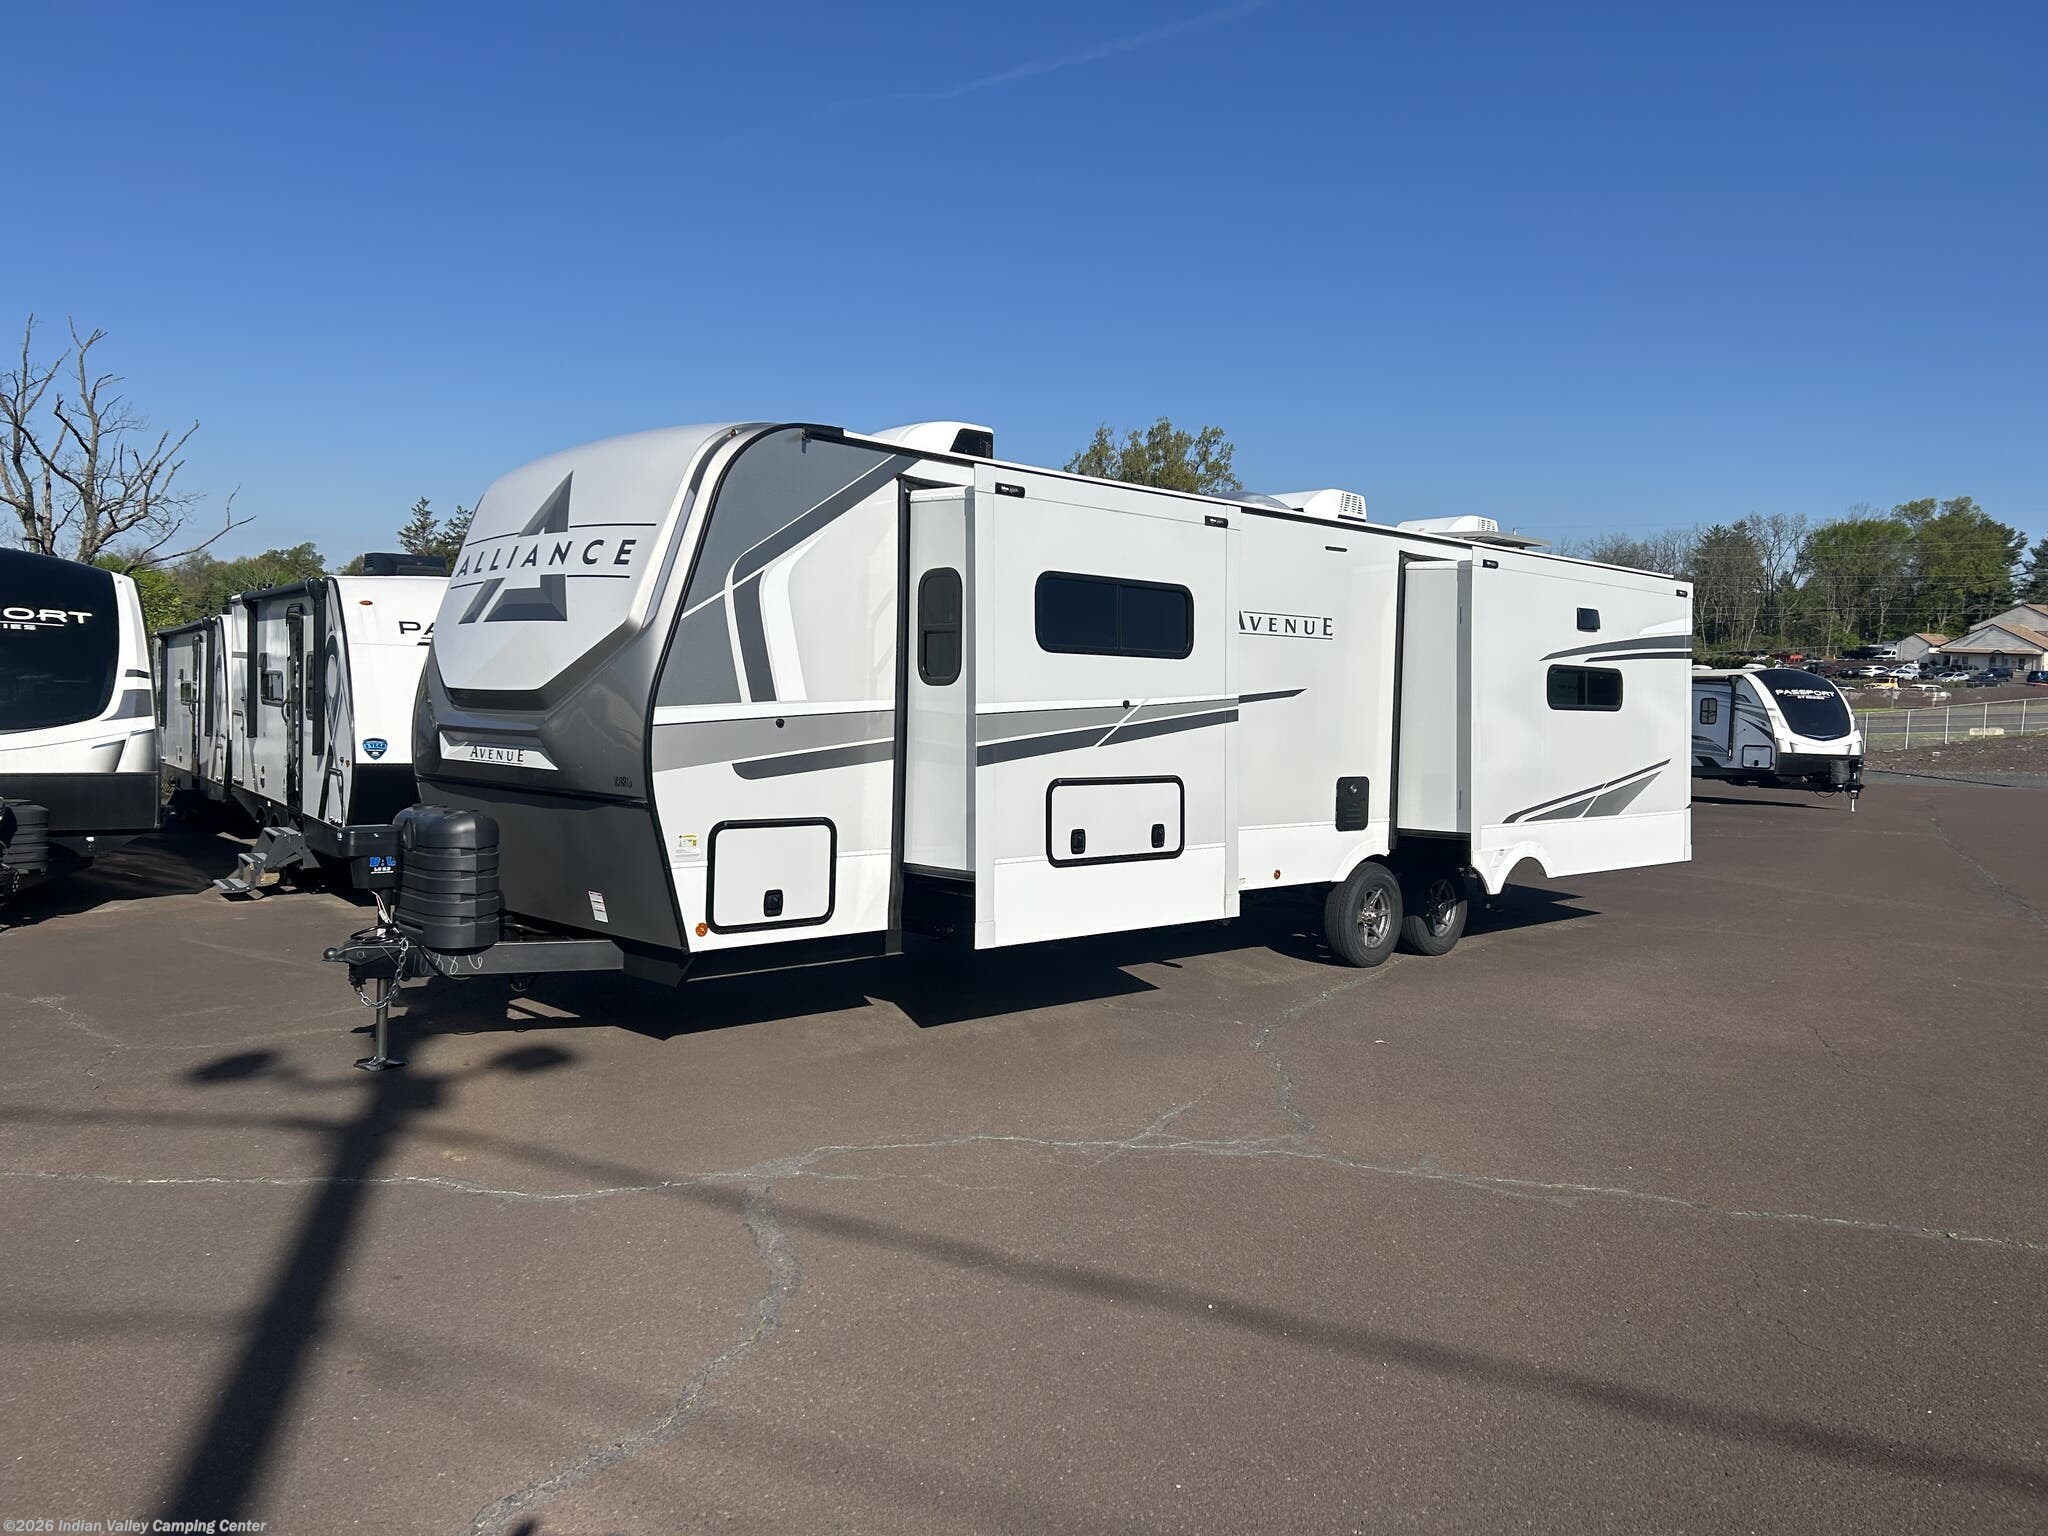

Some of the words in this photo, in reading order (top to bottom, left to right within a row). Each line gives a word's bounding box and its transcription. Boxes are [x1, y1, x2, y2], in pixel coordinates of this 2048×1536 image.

[456, 539, 637, 577] ALLIANCE
[3, 607, 93, 624] ORT
[1775, 689, 1835, 697] PASSPORT
[470, 745, 524, 762] AVENUE
